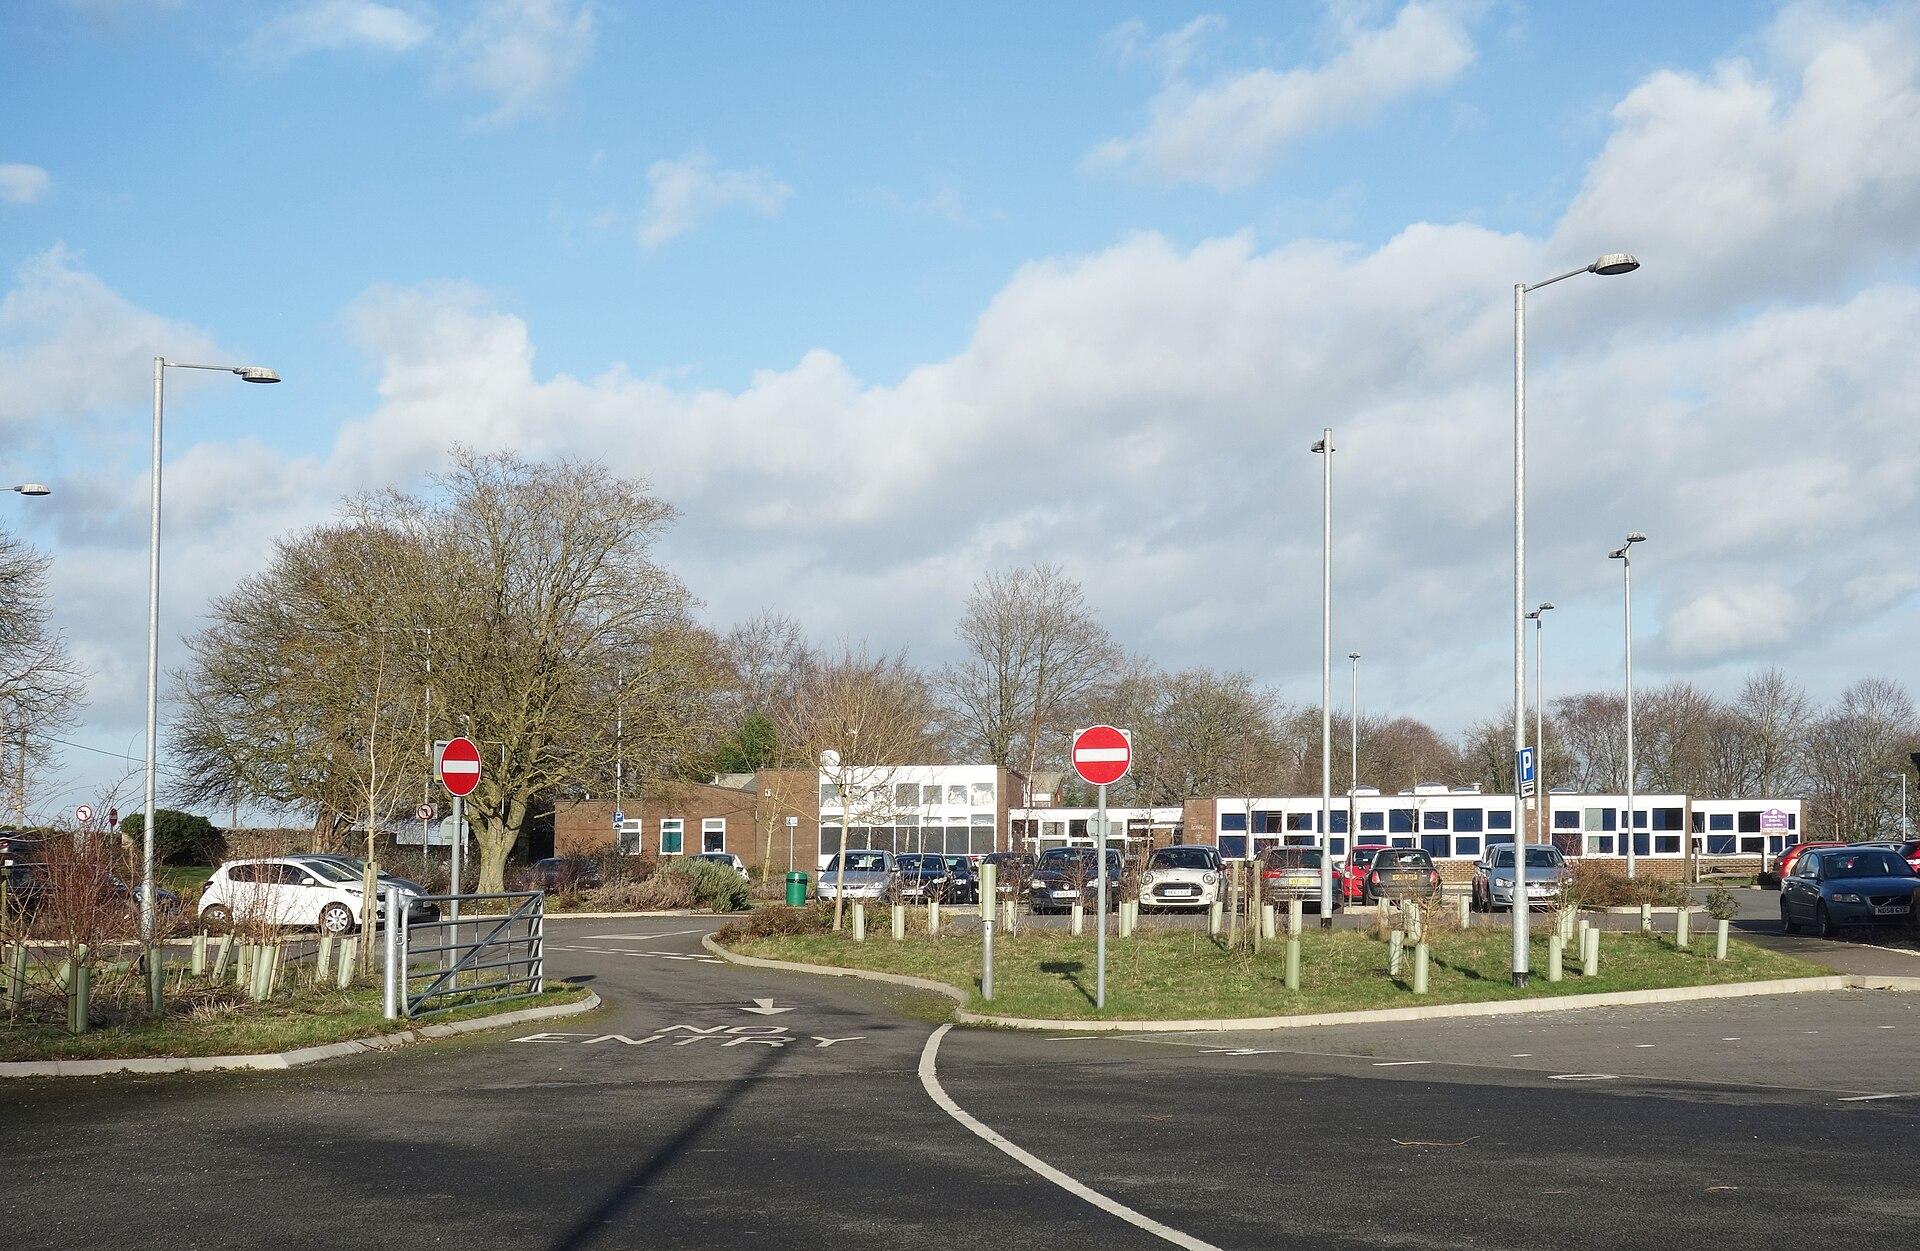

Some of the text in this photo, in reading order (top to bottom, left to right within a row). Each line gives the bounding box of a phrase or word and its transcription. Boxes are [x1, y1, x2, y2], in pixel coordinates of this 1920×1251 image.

[1523, 751, 1531, 779] P
[615, 812, 622, 822] P
[654, 1025, 789, 1034] NO
[509, 1033, 867, 1048] ENTRY
